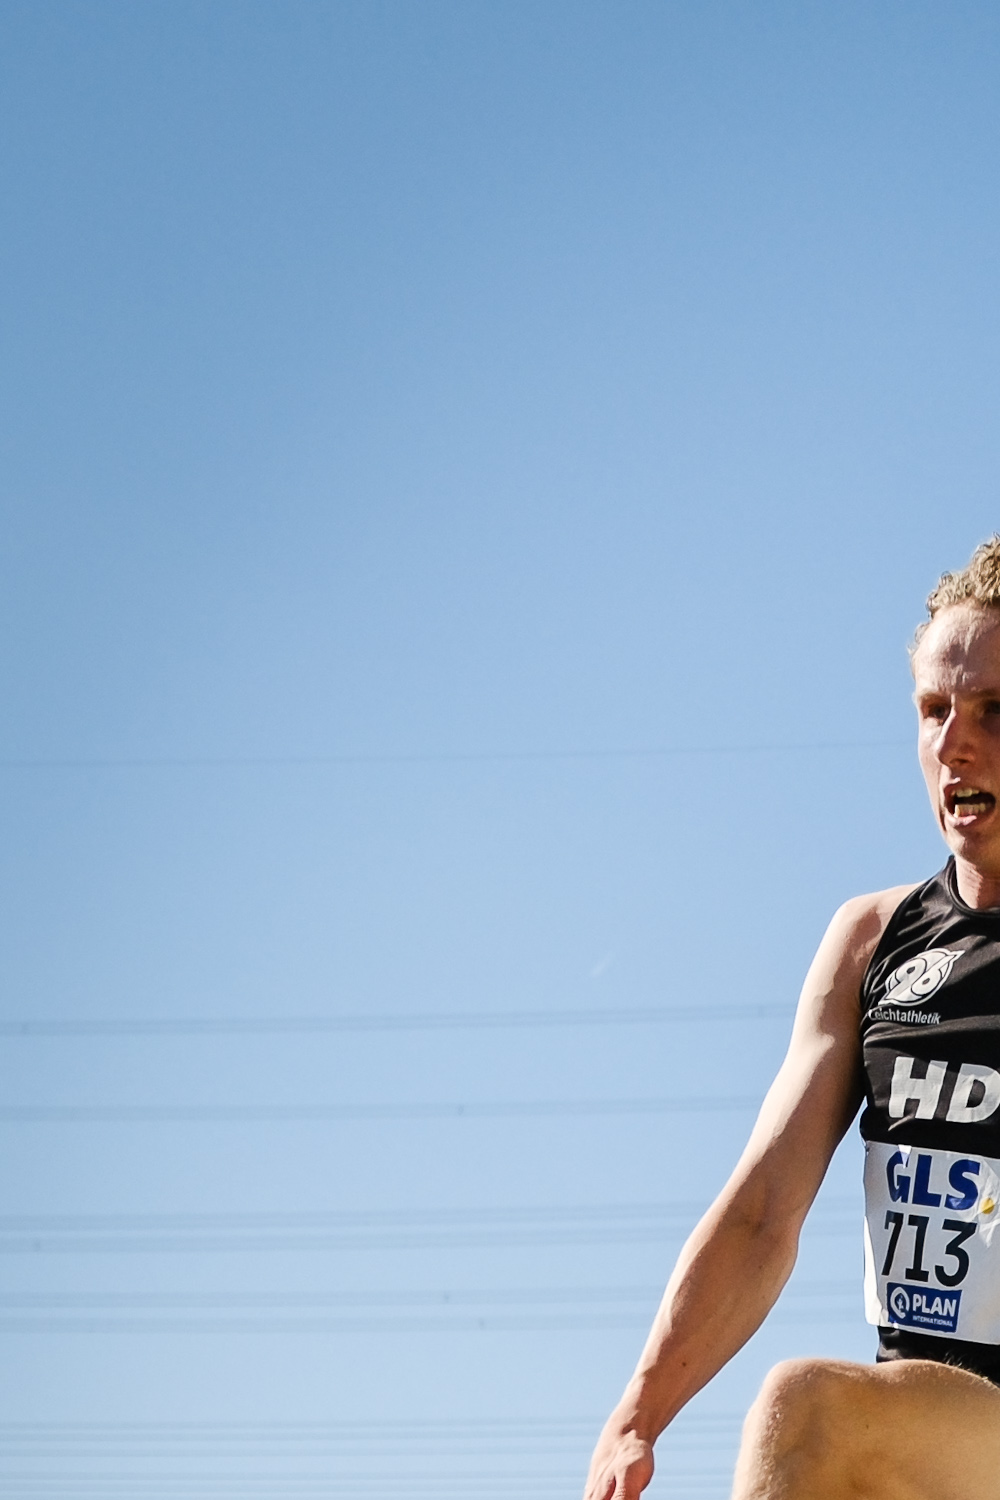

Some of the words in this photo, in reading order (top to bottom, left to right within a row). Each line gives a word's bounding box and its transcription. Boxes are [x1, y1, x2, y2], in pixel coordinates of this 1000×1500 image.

[881, 951, 961, 1003] 96
[868, 1007, 941, 1025] Leichtathletik
[886, 1150, 981, 1211] GLS
[881, 1210, 978, 1287] 713
[912, 1293, 957, 1317] PLAN
